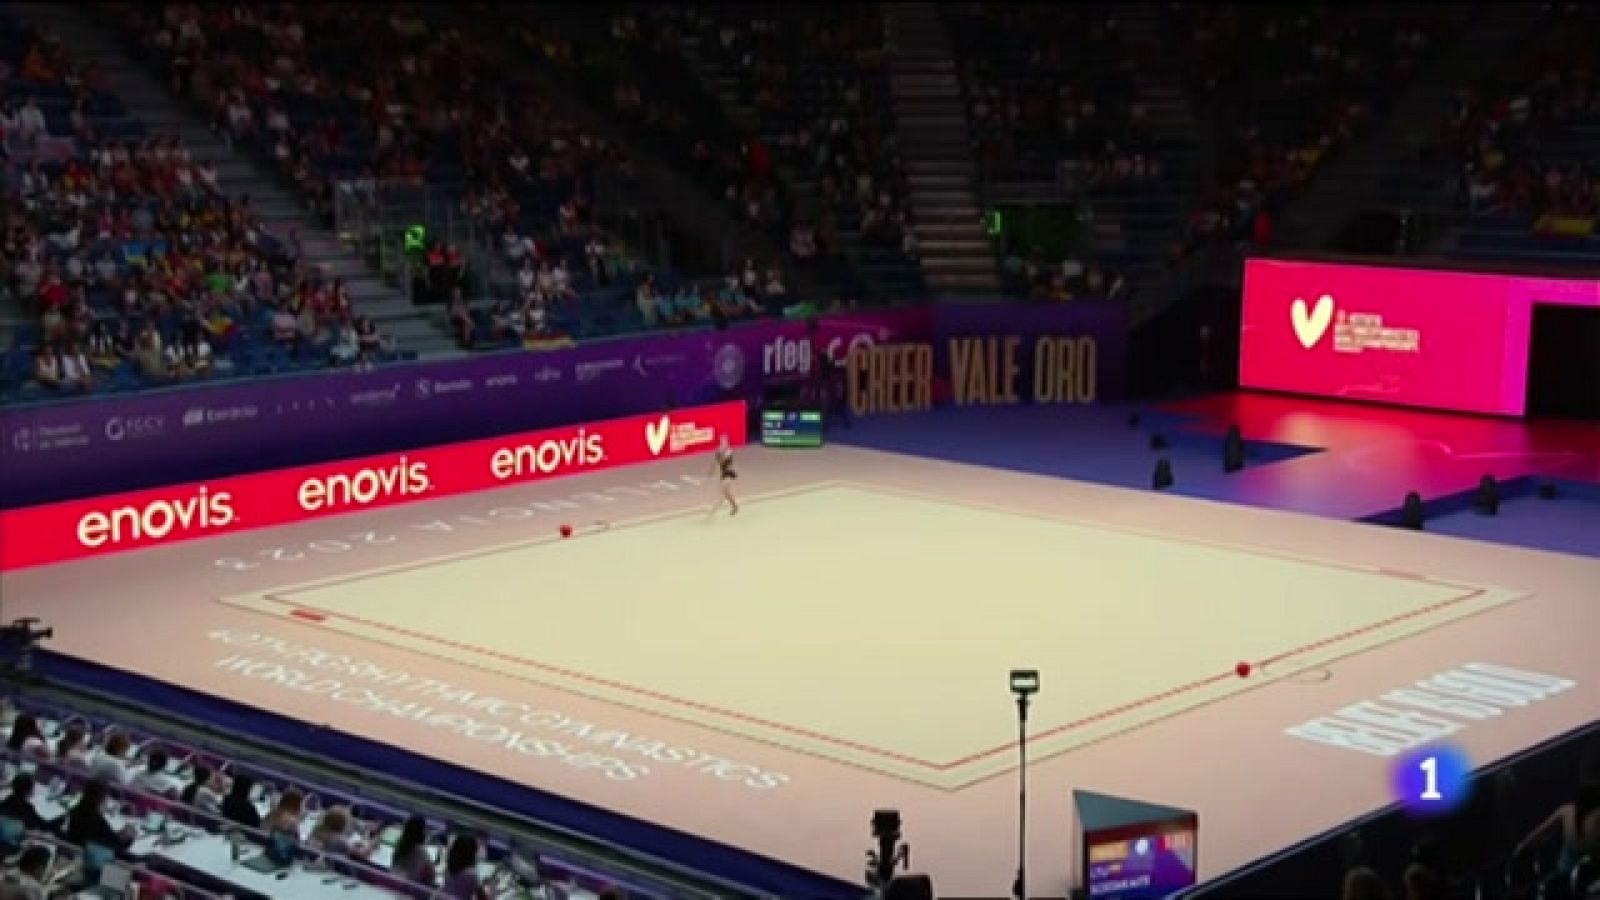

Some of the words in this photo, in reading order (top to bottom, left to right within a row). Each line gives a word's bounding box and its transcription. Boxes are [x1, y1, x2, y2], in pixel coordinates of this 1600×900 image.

[763, 336, 812, 375] rfeg
[848, 342, 933, 416] CREER
[949, 336, 1020, 406] VALE
[1034, 336, 1096, 405] ORO
[491, 429, 604, 479] enovis
[297, 456, 429, 511] enovis
[77, 485, 235, 547] enovis
